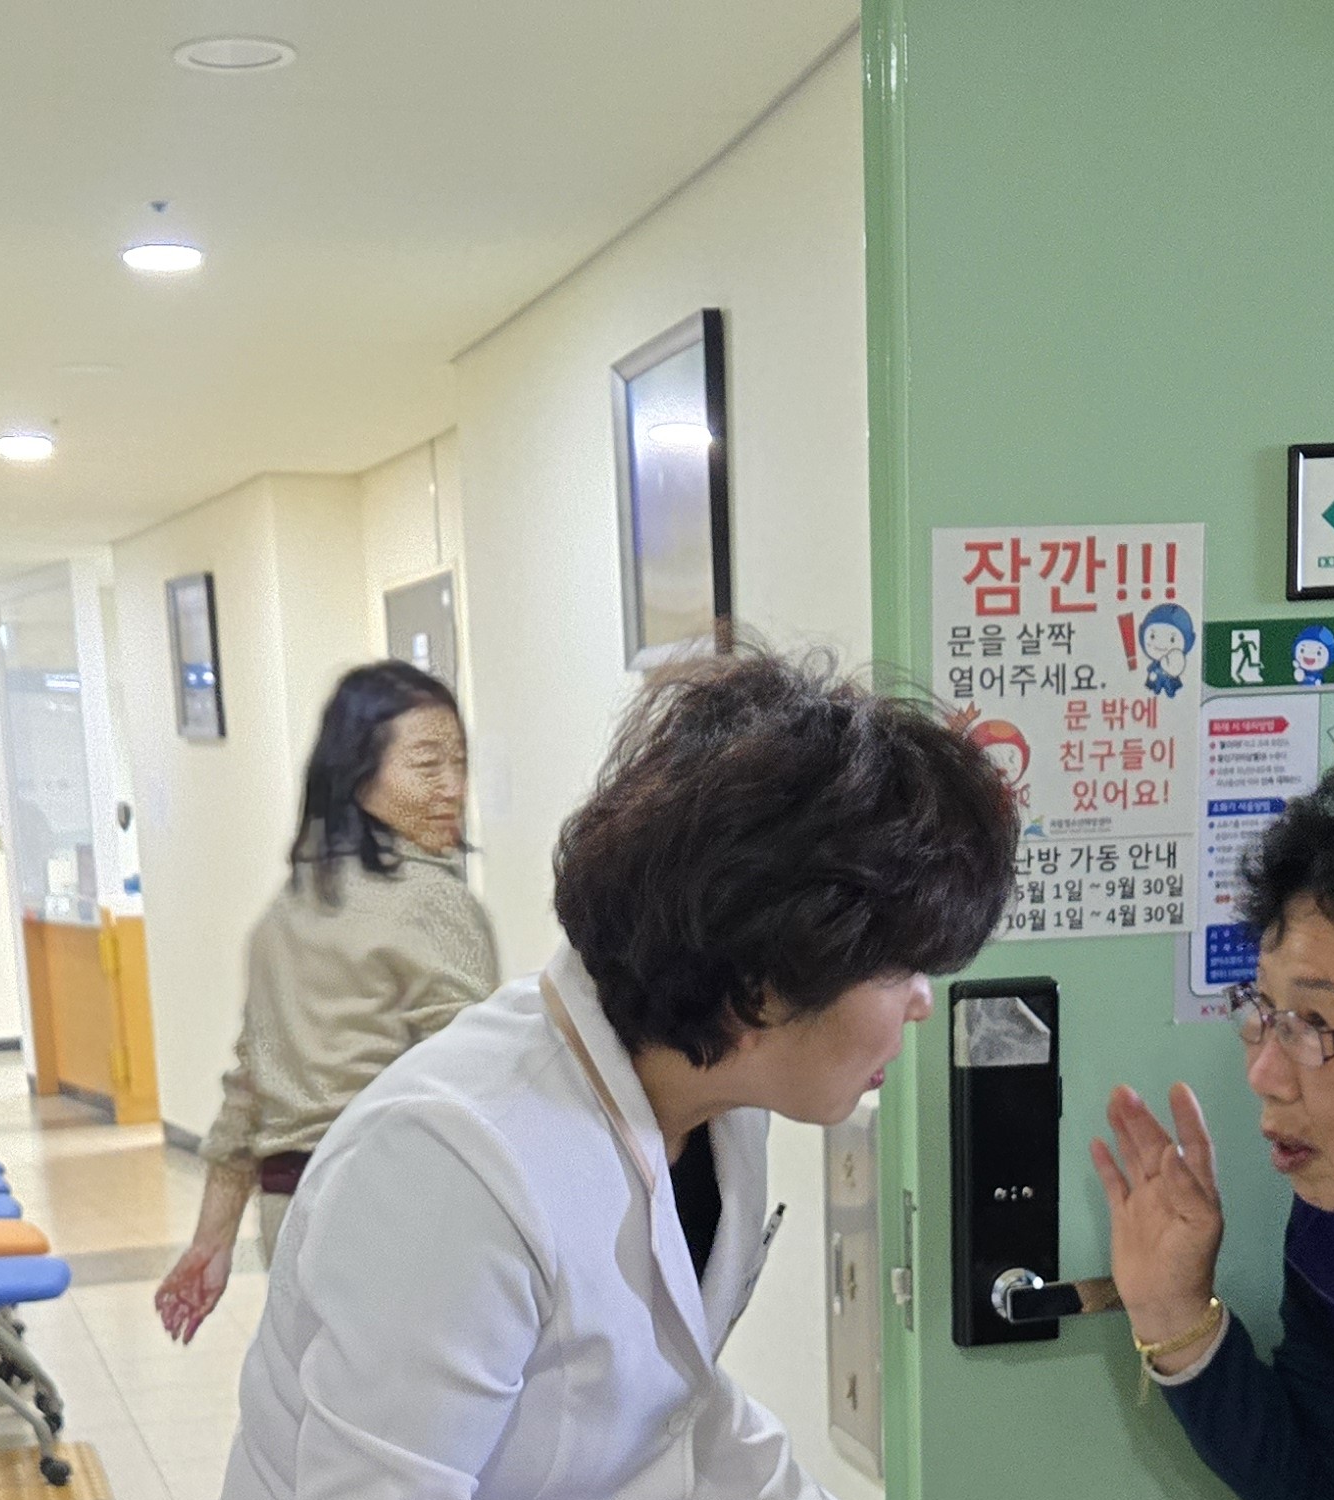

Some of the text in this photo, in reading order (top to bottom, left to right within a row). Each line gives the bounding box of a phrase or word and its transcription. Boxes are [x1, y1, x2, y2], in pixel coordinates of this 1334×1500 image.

[962, 536, 1177, 617] 잠깐!!!
[947, 621, 1076, 658] 문을 살짝
[949, 663, 1107, 699] 열어주세요.
[1064, 696, 1158, 731] 문 밖에
[1059, 736, 1175, 772] 친구들이
[1072, 778, 1170, 812] 있어요!
[1069, 844, 1120, 874] 가동
[1128, 841, 1178, 871] 안내
[1053, 878, 1083, 902] 1일
[1105, 876, 1135, 900] 9월
[1142, 873, 1184, 897] 30일
[1053, 906, 1083, 930] 1일
[1106, 904, 1136, 927] 4월
[1143, 902, 1184, 925] 30일
